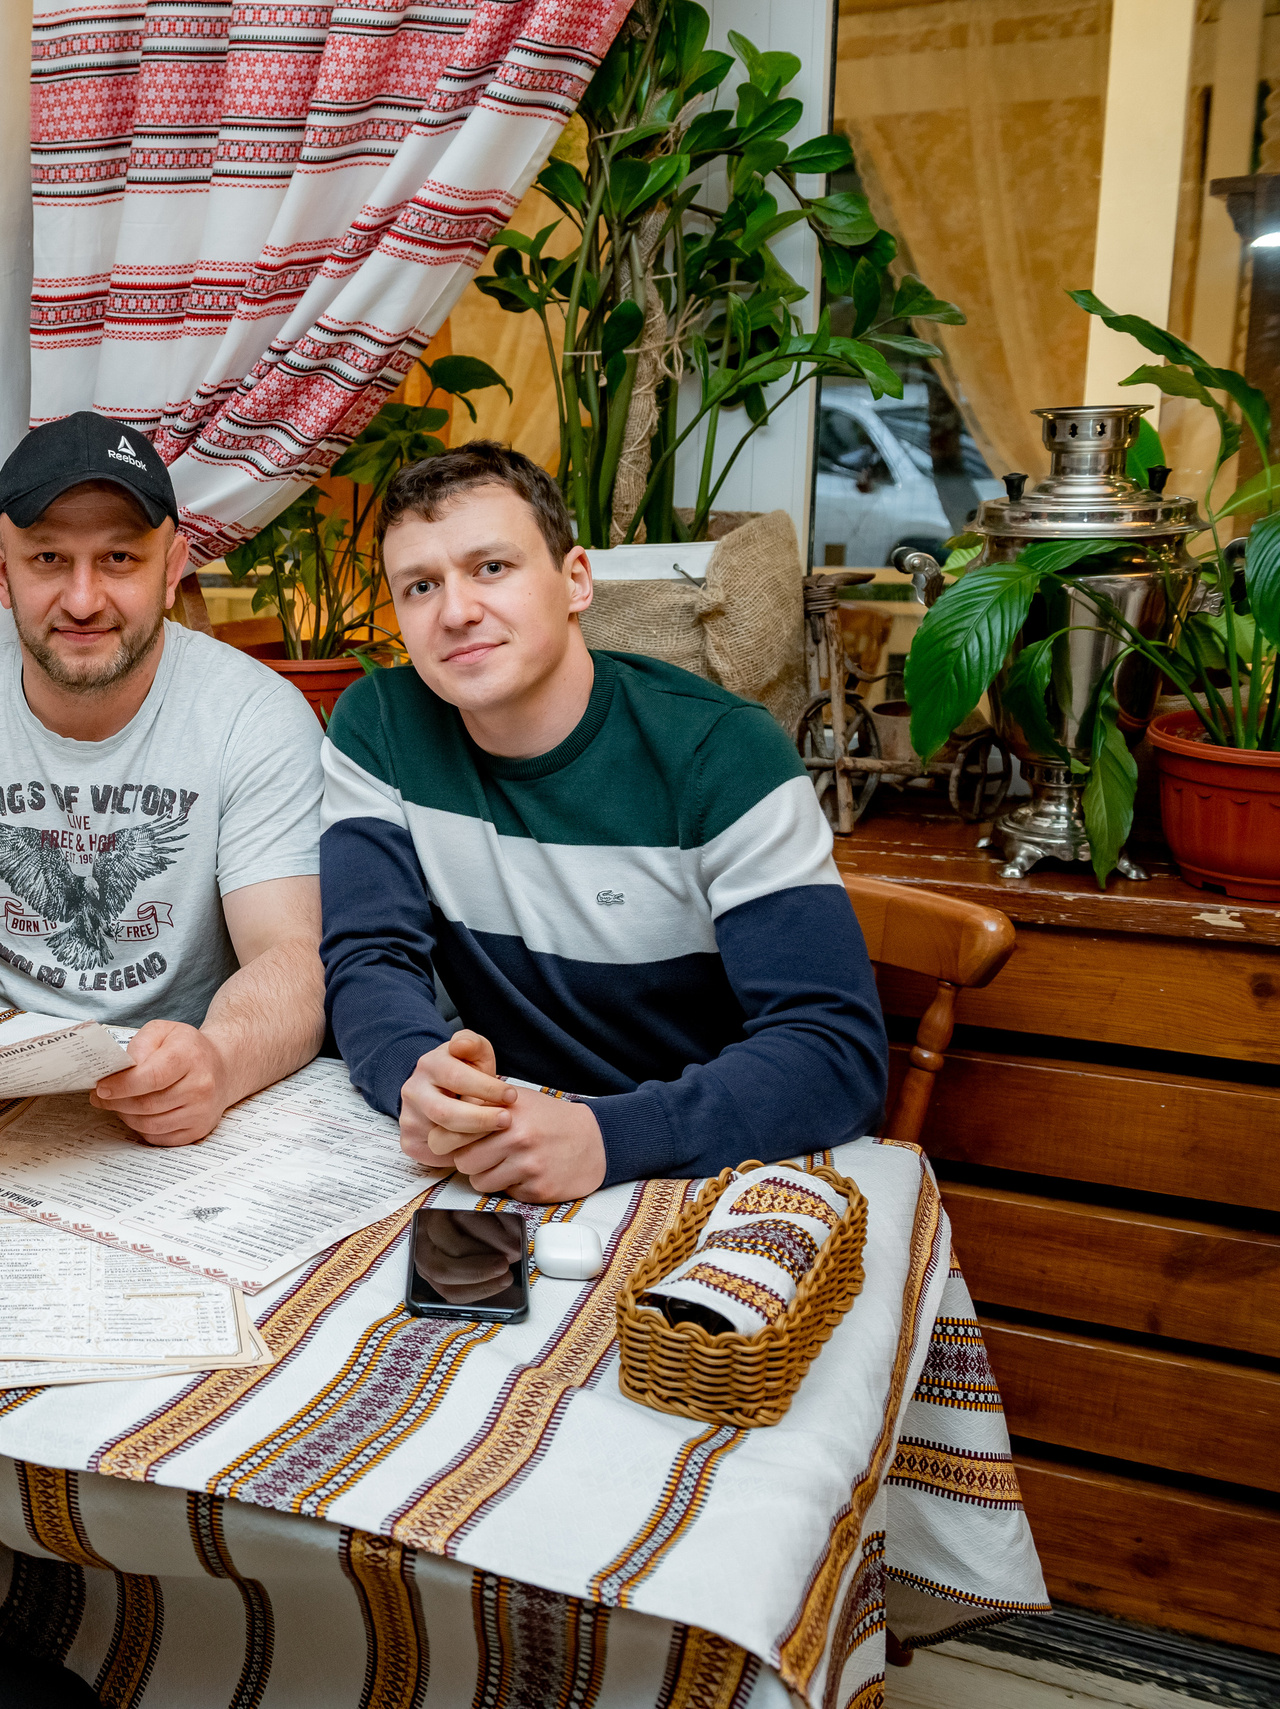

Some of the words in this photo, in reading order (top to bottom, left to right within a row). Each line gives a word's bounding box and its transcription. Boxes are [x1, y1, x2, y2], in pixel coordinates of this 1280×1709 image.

[107, 449, 147, 471] Reebok
[51, 783, 80, 814] OF
[90, 783, 200, 819] VICTORY
[67, 815, 91, 830] LIVE
[41, 829, 74, 850] FREE
[11, 917, 40, 933] BORN
[127, 923, 155, 938] FREE
[78, 951, 168, 991] LEGEND
[39, 1031, 78, 1048] КАРТА
[0, 1189, 43, 1208] ВИННАЯ
